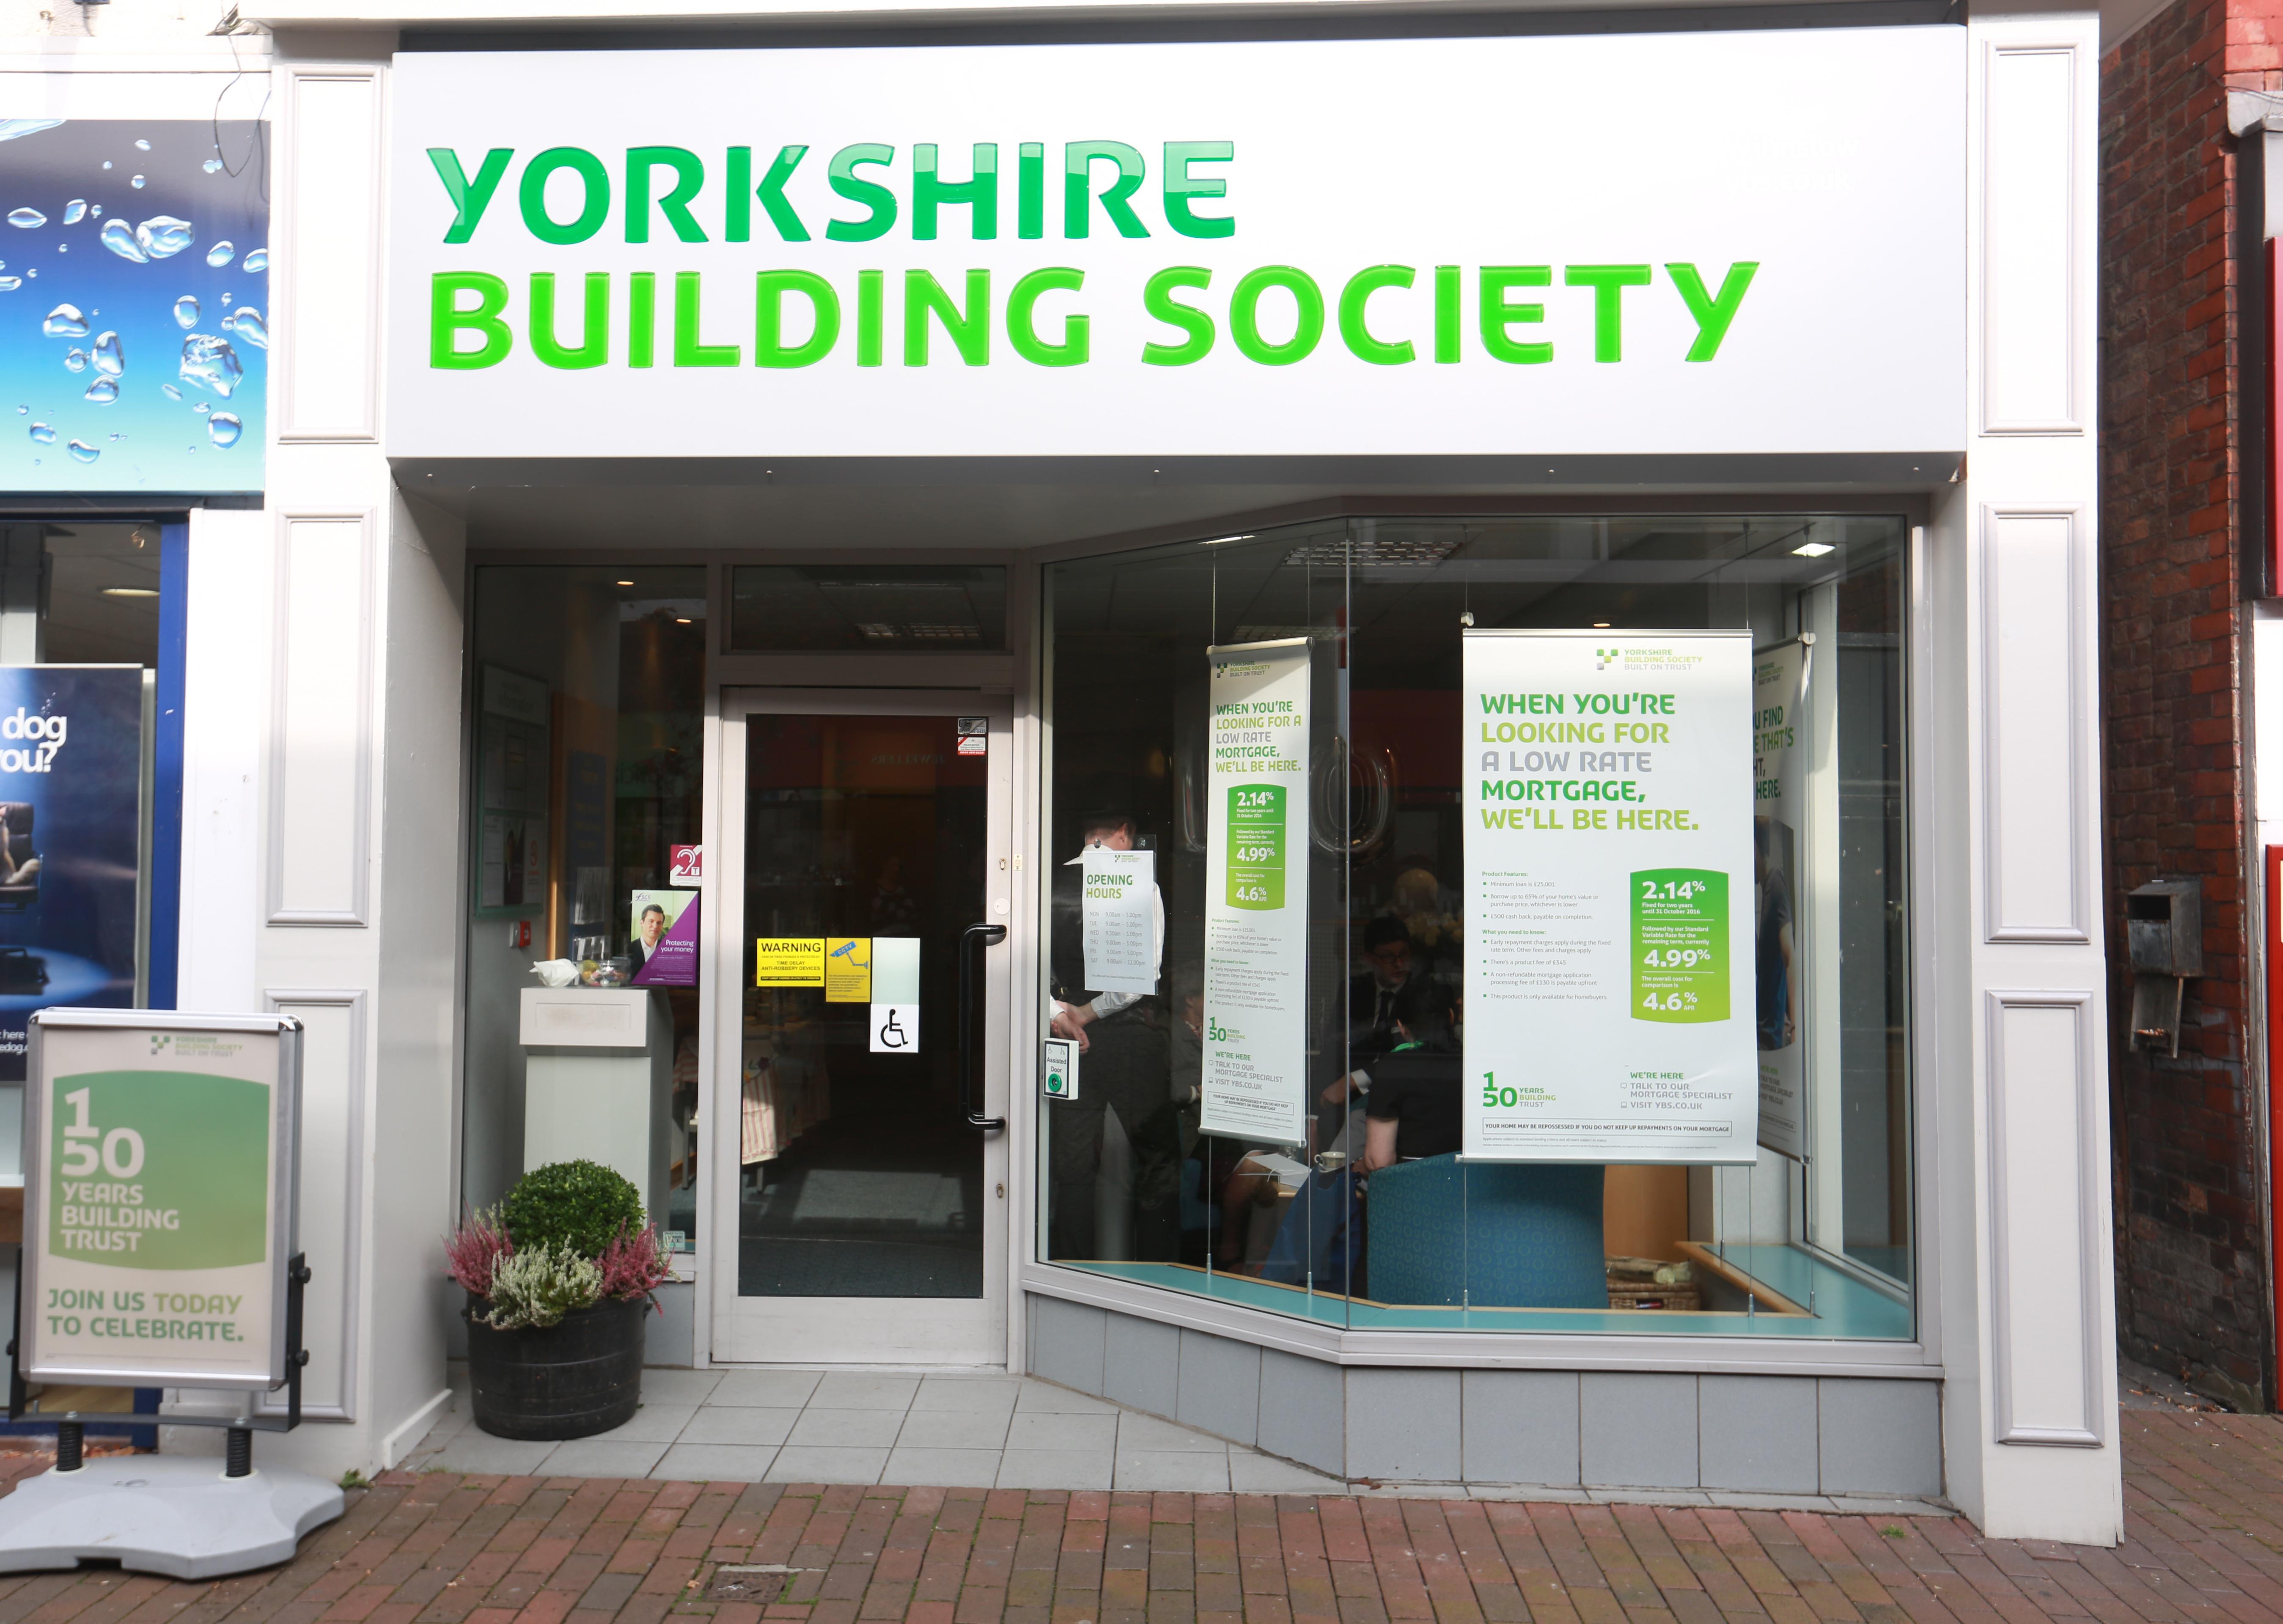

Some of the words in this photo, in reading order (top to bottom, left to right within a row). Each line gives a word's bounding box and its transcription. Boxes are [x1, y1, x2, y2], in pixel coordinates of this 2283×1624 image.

[427, 143, 1235, 241] YORKSHIRE
[430, 270, 1089, 368] BUILDING
[1142, 265, 1758, 364] SOCIETY
[1217, 704, 1248, 715] WHEN
[1252, 701, 1292, 713] YOU'RE
[1481, 694, 1563, 713] WHEN
[1573, 692, 1675, 714] YOU'RE
[1217, 717, 1264, 729] LOOKING
[1268, 716, 1290, 727] FOR
[1294, 715, 1301, 726] A
[1763, 705, 1783, 727] FIND
[3, 708, 66, 748] dog
[1482, 722, 1604, 742] LOOKING
[1615, 723, 1669, 743] FOR
[1216, 733, 1239, 743] LOW
[1243, 732, 1271, 742] RATE
[1761, 727, 1794, 752] THAT'S
[0, 740, 58, 773] ou?
[1216, 746, 1280, 757] MORTGAGE,
[1216, 761, 1247, 772] WE'LL
[1250, 761, 1264, 771] BE
[1268, 760, 1301, 771] HERE.
[1482, 751, 1498, 771] A
[1510, 752, 1570, 771] LOW
[1580, 752, 1651, 771] RATE
[1482, 780, 1645, 802] MORTGAGE,
[1756, 779, 1780, 799] HERE.
[1237, 792, 1274, 806] 2.14%
[1481, 808, 1563, 829] WE'LL
[1573, 809, 1607, 829] BE
[1617, 809, 1698, 830] HERE.
[1236, 848, 1275, 861] 4.99%
[1087, 875, 1132, 885] OPENING
[1086, 888, 1121, 898] HOURS
[1642, 881, 1706, 899] 2.14%
[665, 939, 694, 948] Protecting
[761, 943, 821, 952] WARNING
[838, 944, 852, 954] CCTV
[1644, 949, 1711, 967] 4.99%
[3, 1029, 25, 1040] here
[1214, 1060, 1231, 1068] TALK
[1215, 1069, 1247, 1078] MORTGAGE
[1249, 1073, 1283, 1082] SPECIALIST
[1231, 1081, 1262, 1089] YBS.CO.UK
[62, 1182, 143, 1204] YEARS
[62, 1206, 179, 1229] BUILDING
[60, 1229, 142, 1250] TRUST
[48, 1289, 104, 1309] JOIN
[113, 1292, 145, 1311] US
[154, 1294, 242, 1313] TODAY
[47, 1316, 81, 1335] TO
[90, 1318, 243, 1341] CELEBRATE.
